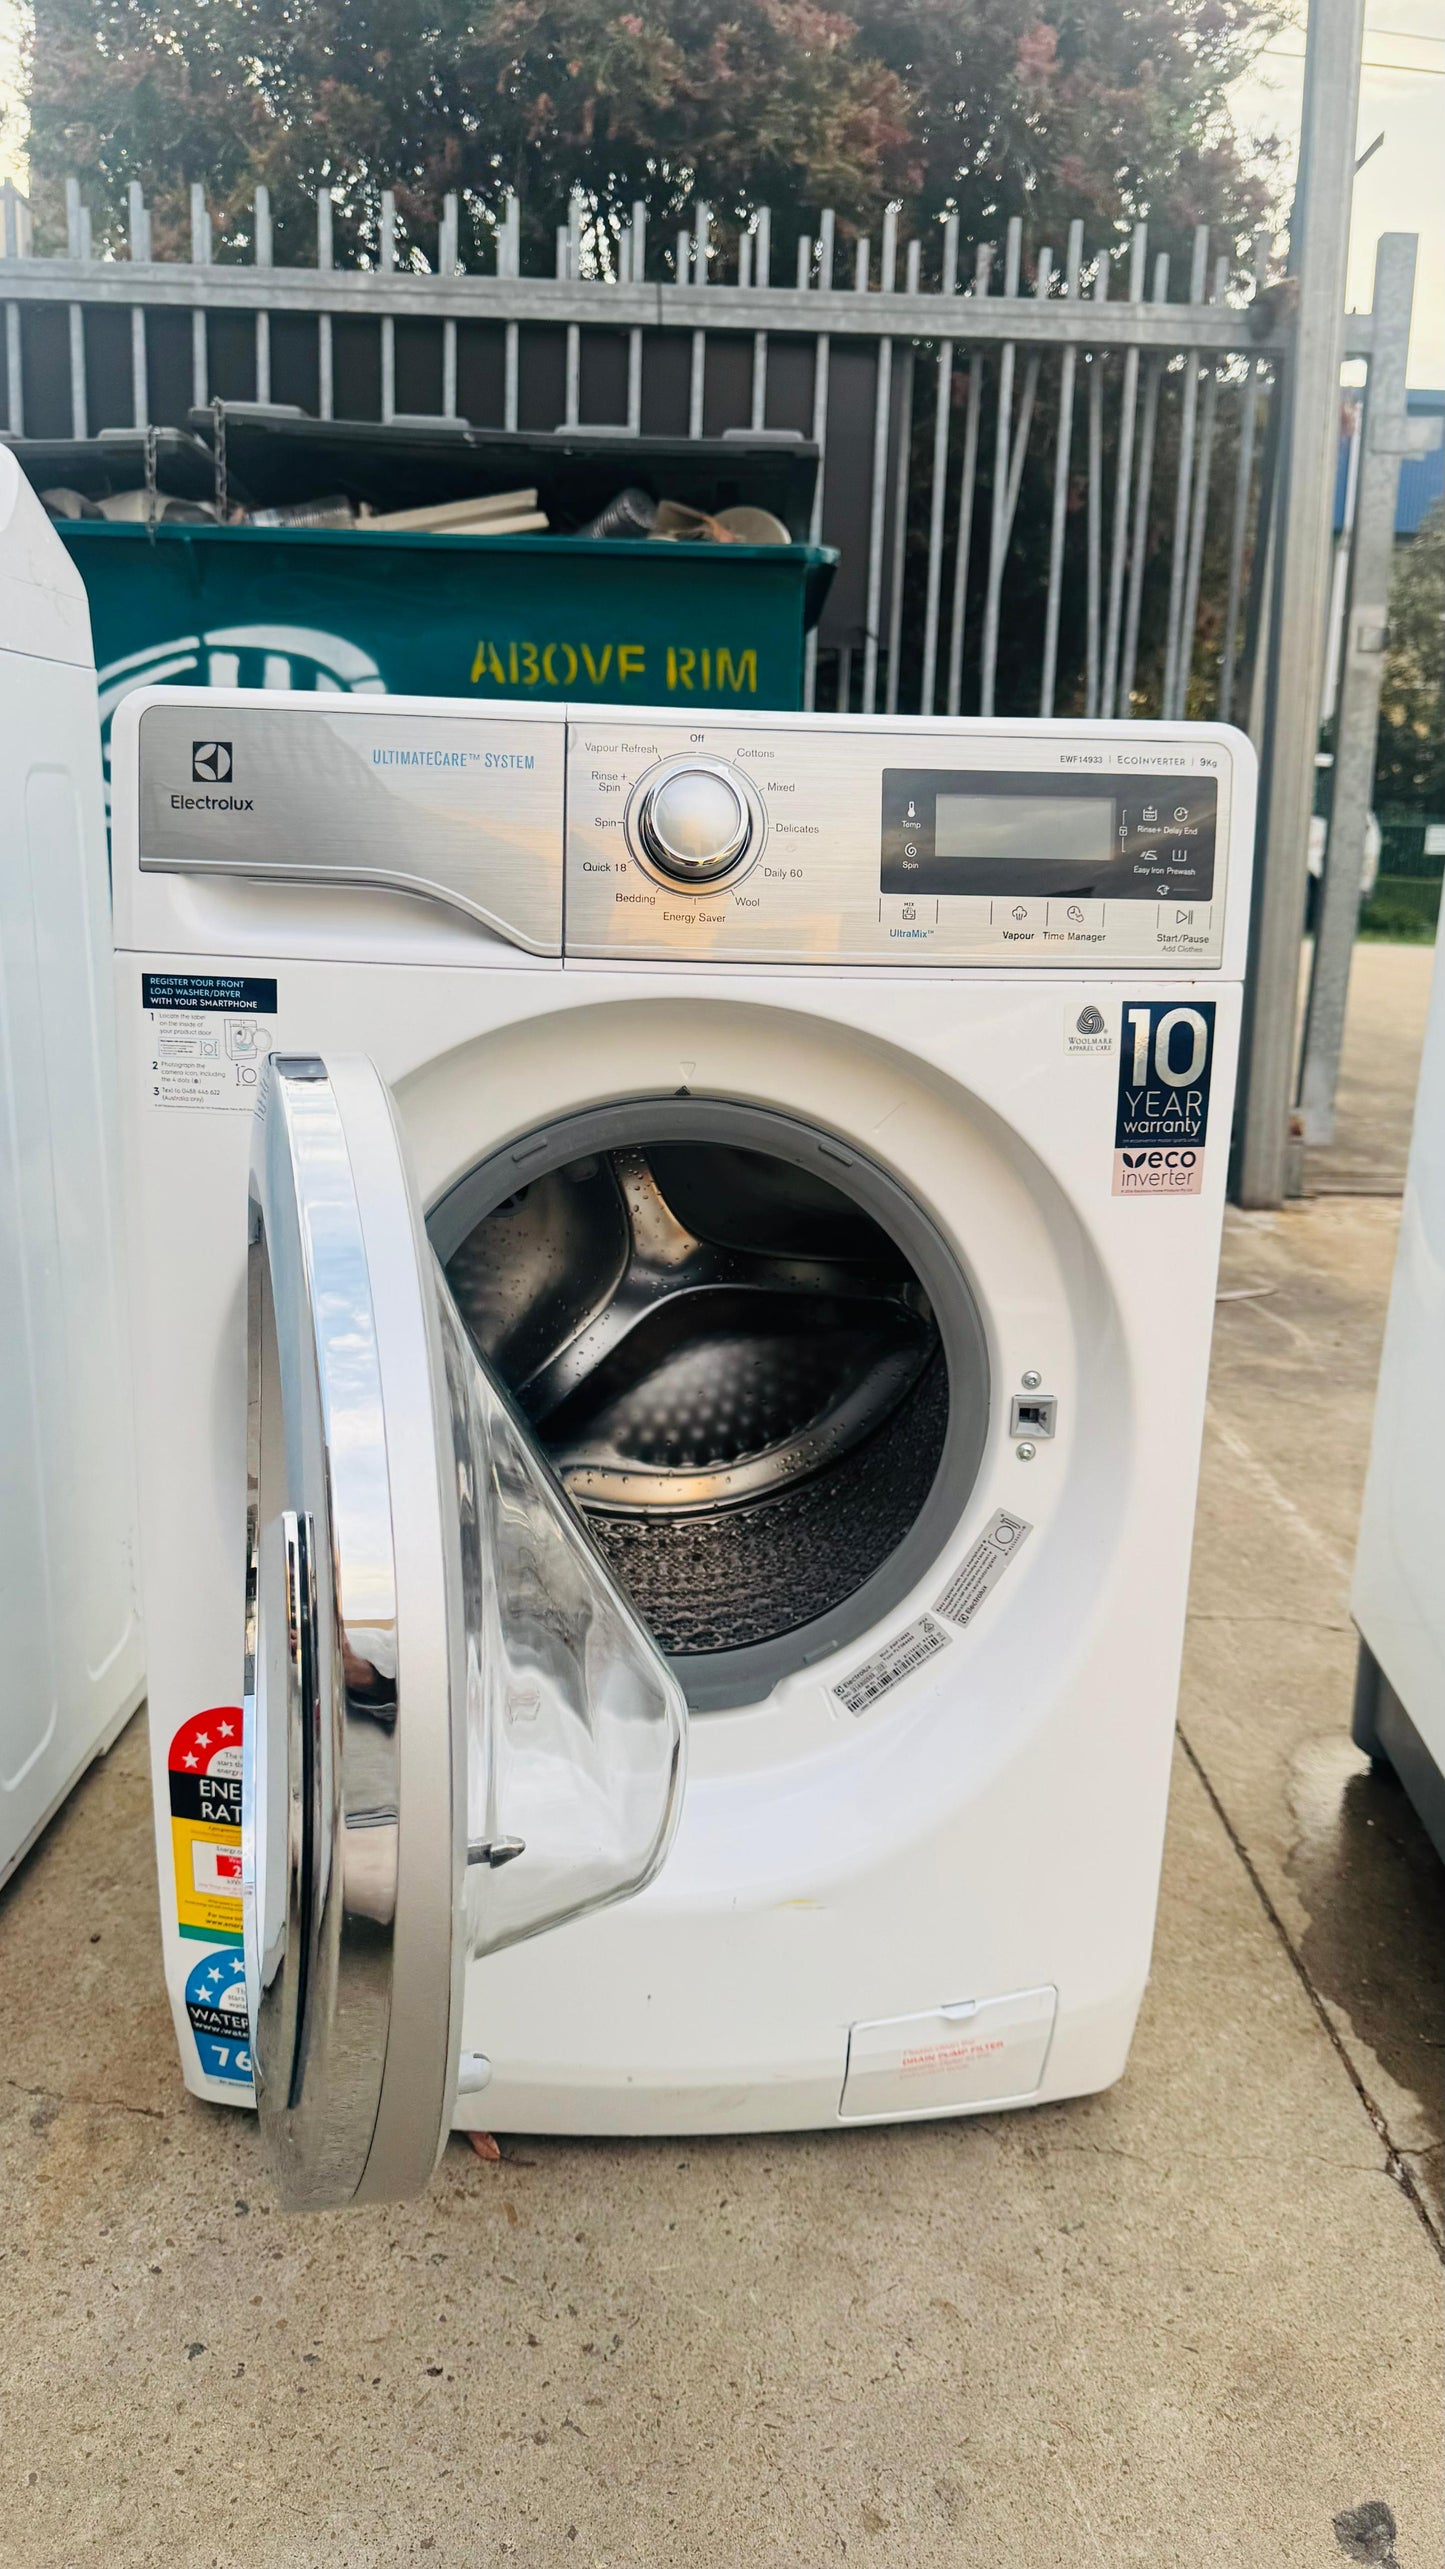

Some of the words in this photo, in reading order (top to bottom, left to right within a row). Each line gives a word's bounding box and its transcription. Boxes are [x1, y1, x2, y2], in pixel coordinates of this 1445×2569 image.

[666, 646, 757, 693] RIM
[690, 733, 705, 743] Off
[584, 742, 618, 753] Vapour
[621, 743, 658, 754] Refresh
[736, 747, 775, 758] Cottons
[484, 752, 534, 769] SYSTEM
[1060, 755, 1103, 764] EWF14933
[591, 771, 618, 780] Rinse
[598, 782, 621, 793] Spin
[767, 782, 795, 792] Mixed
[171, 794, 254, 811] Electrolux
[594, 817, 617, 829] Spin
[775, 823, 820, 834] Delicates
[902, 820, 921, 829] Temp
[1137, 825, 1162, 834] Rinse+
[1163, 826, 1182, 836] Delay
[1184, 827, 1198, 835] End
[582, 862, 611, 872] Quick
[615, 863, 627, 872] 18
[902, 861, 919, 870] Spin
[1134, 866, 1150, 875] Easy
[1151, 866, 1165, 874] Iron
[764, 868, 787, 880] Daily
[790, 869, 803, 878] 60
[1166, 867, 1196, 876] Prewash
[615, 893, 656, 905] Bedding
[735, 897, 760, 907] Wool
[663, 911, 696, 924] Energy
[698, 912, 726, 923] Saver
[1002, 931, 1035, 942] Vapour
[1043, 931, 1065, 941] Time
[1067, 932, 1107, 943] Manager
[1156, 933, 1210, 945] Start/Pause
[150, 977, 188, 986] REGISTER
[190, 979, 214, 987] YOUR
[216, 980, 245, 989] FRONT
[150, 987, 174, 995] LOAD
[176, 988, 241, 998] WASHER/DRYER
[150, 997, 172, 1005] WITH
[174, 998, 198, 1006] YOUR
[200, 999, 258, 1009] SMARTPHONE
[150, 1012, 155, 1021] 1
[1068, 1037, 1112, 1045] WOOLMARK
[1128, 1007, 1208, 1088] 10
[152, 1061, 158, 1070] 2
[153, 1086, 160, 1096] 3
[1125, 1090, 1202, 1118] YEAR
[1123, 1117, 1201, 1137] warranty
[1148, 1151, 1196, 1169] eco
[1121, 1169, 1194, 1187] inverter
[965, 1584, 988, 1614] Electrolux
[842, 1664, 872, 1688] Electrolux
[199, 1778, 241, 1801] ENE
[201, 1801, 243, 1823] RAT
